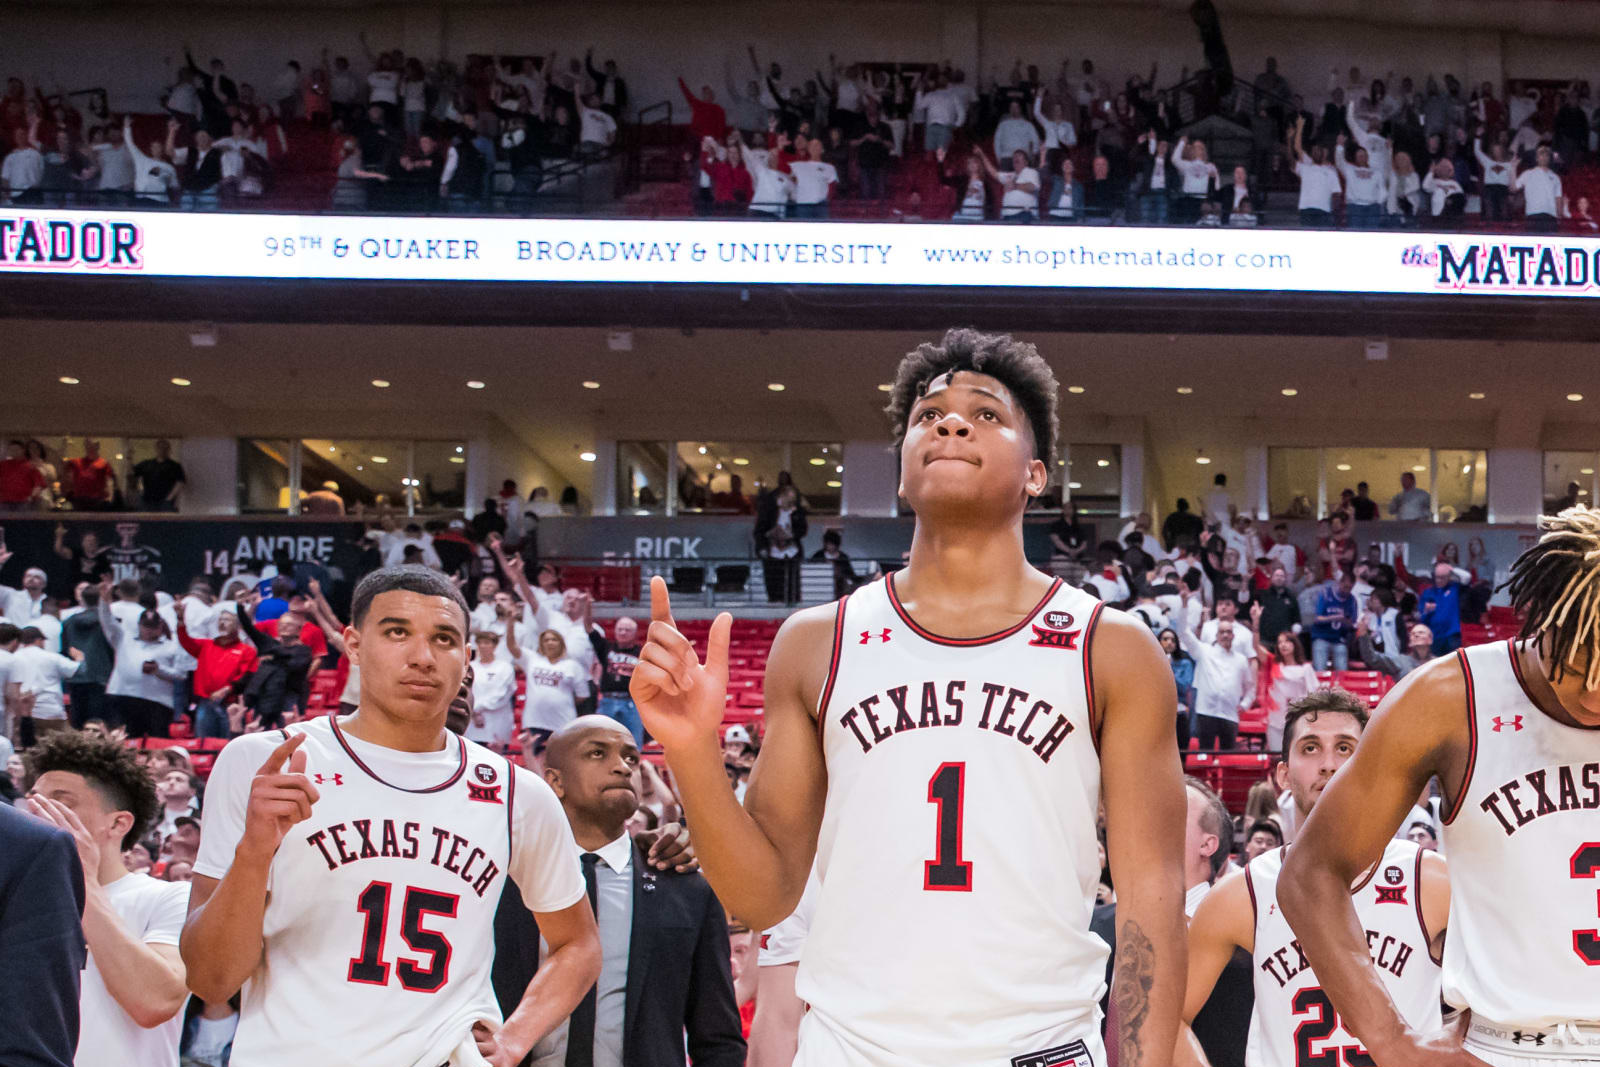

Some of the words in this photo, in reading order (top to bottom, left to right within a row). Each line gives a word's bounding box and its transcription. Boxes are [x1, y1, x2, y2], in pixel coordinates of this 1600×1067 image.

[263, 235, 323, 258] 98TH
[332, 238, 350, 258] &
[360, 238, 481, 260] QUAKER
[516, 240, 682, 263] BROADWAY
[690, 242, 708, 262] &
[717, 242, 893, 265] UNIVERSITY
[1401, 245, 1437, 266] the
[204, 551, 229, 575] 14
[635, 537, 703, 558] RICK
[839, 680, 967, 754] TEXAS
[977, 682, 1076, 764] TECH
[1479, 762, 1600, 837] TEXAS
[923, 761, 973, 892] 1
[306, 819, 421, 871] TEXAS
[430, 826, 500, 898] TECH
[347, 880, 461, 993] 15
